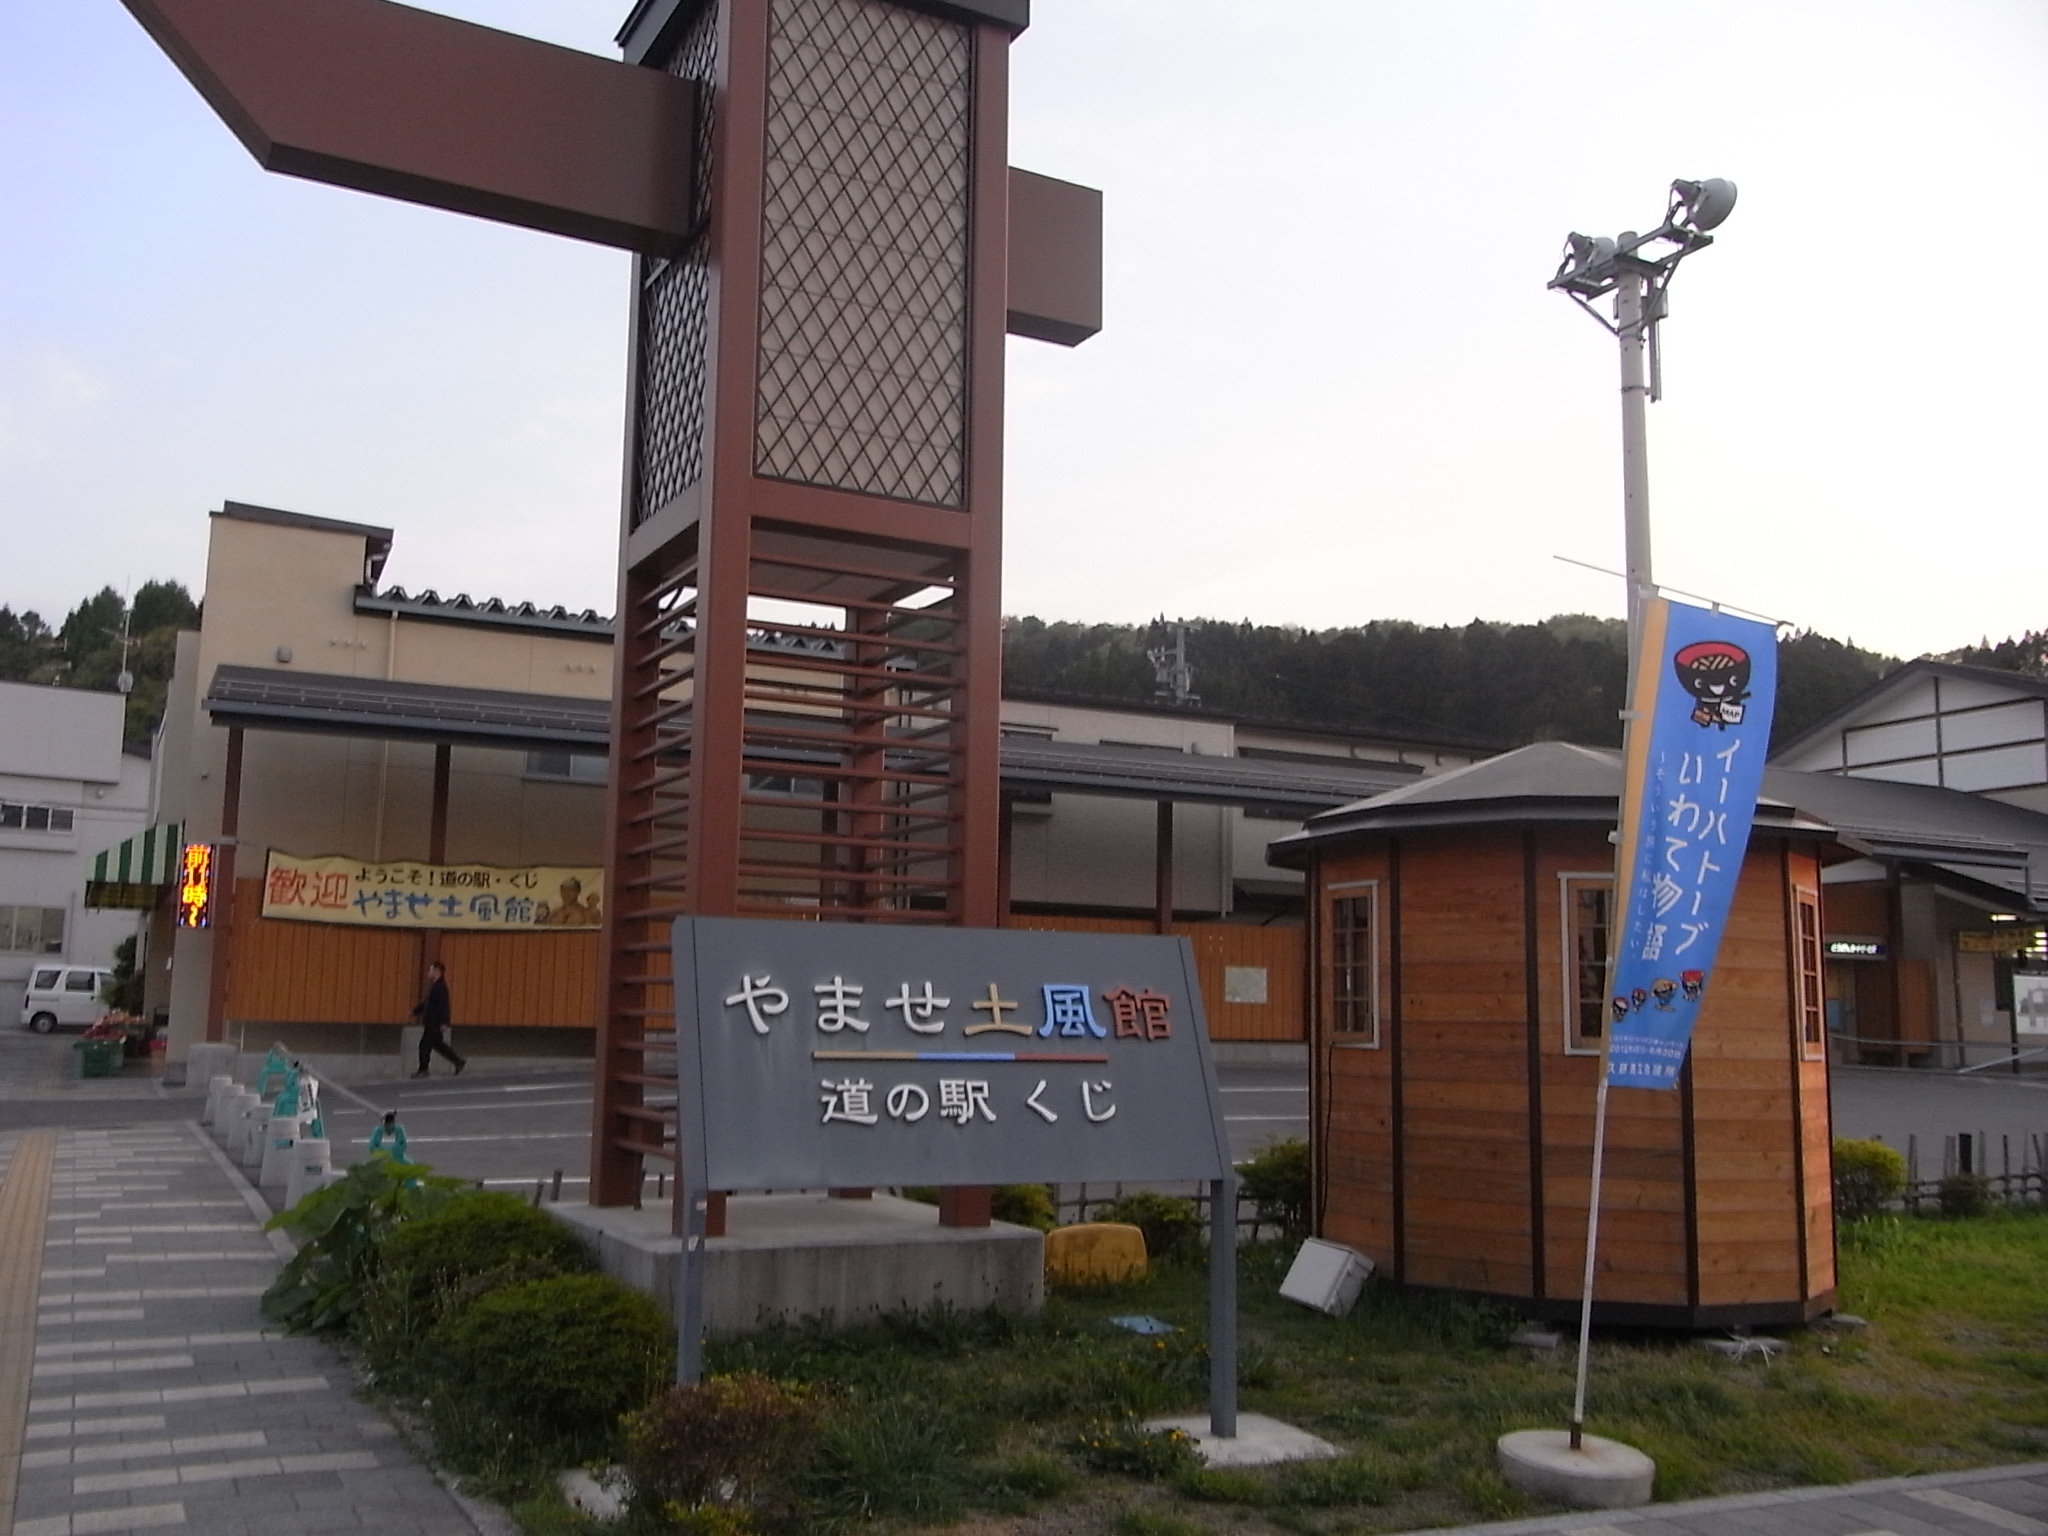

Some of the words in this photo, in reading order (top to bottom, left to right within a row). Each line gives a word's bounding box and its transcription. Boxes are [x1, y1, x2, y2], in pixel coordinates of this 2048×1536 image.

[1722, 707, 1740, 718] MAP
[1642, 752, 1702, 960] いわて物語
[1675, 739, 1741, 955] イーハトーブ
[269, 865, 349, 909] 歓迎
[353, 889, 535, 924] やませ土風館
[725, 974, 1172, 1040] やませ土風館
